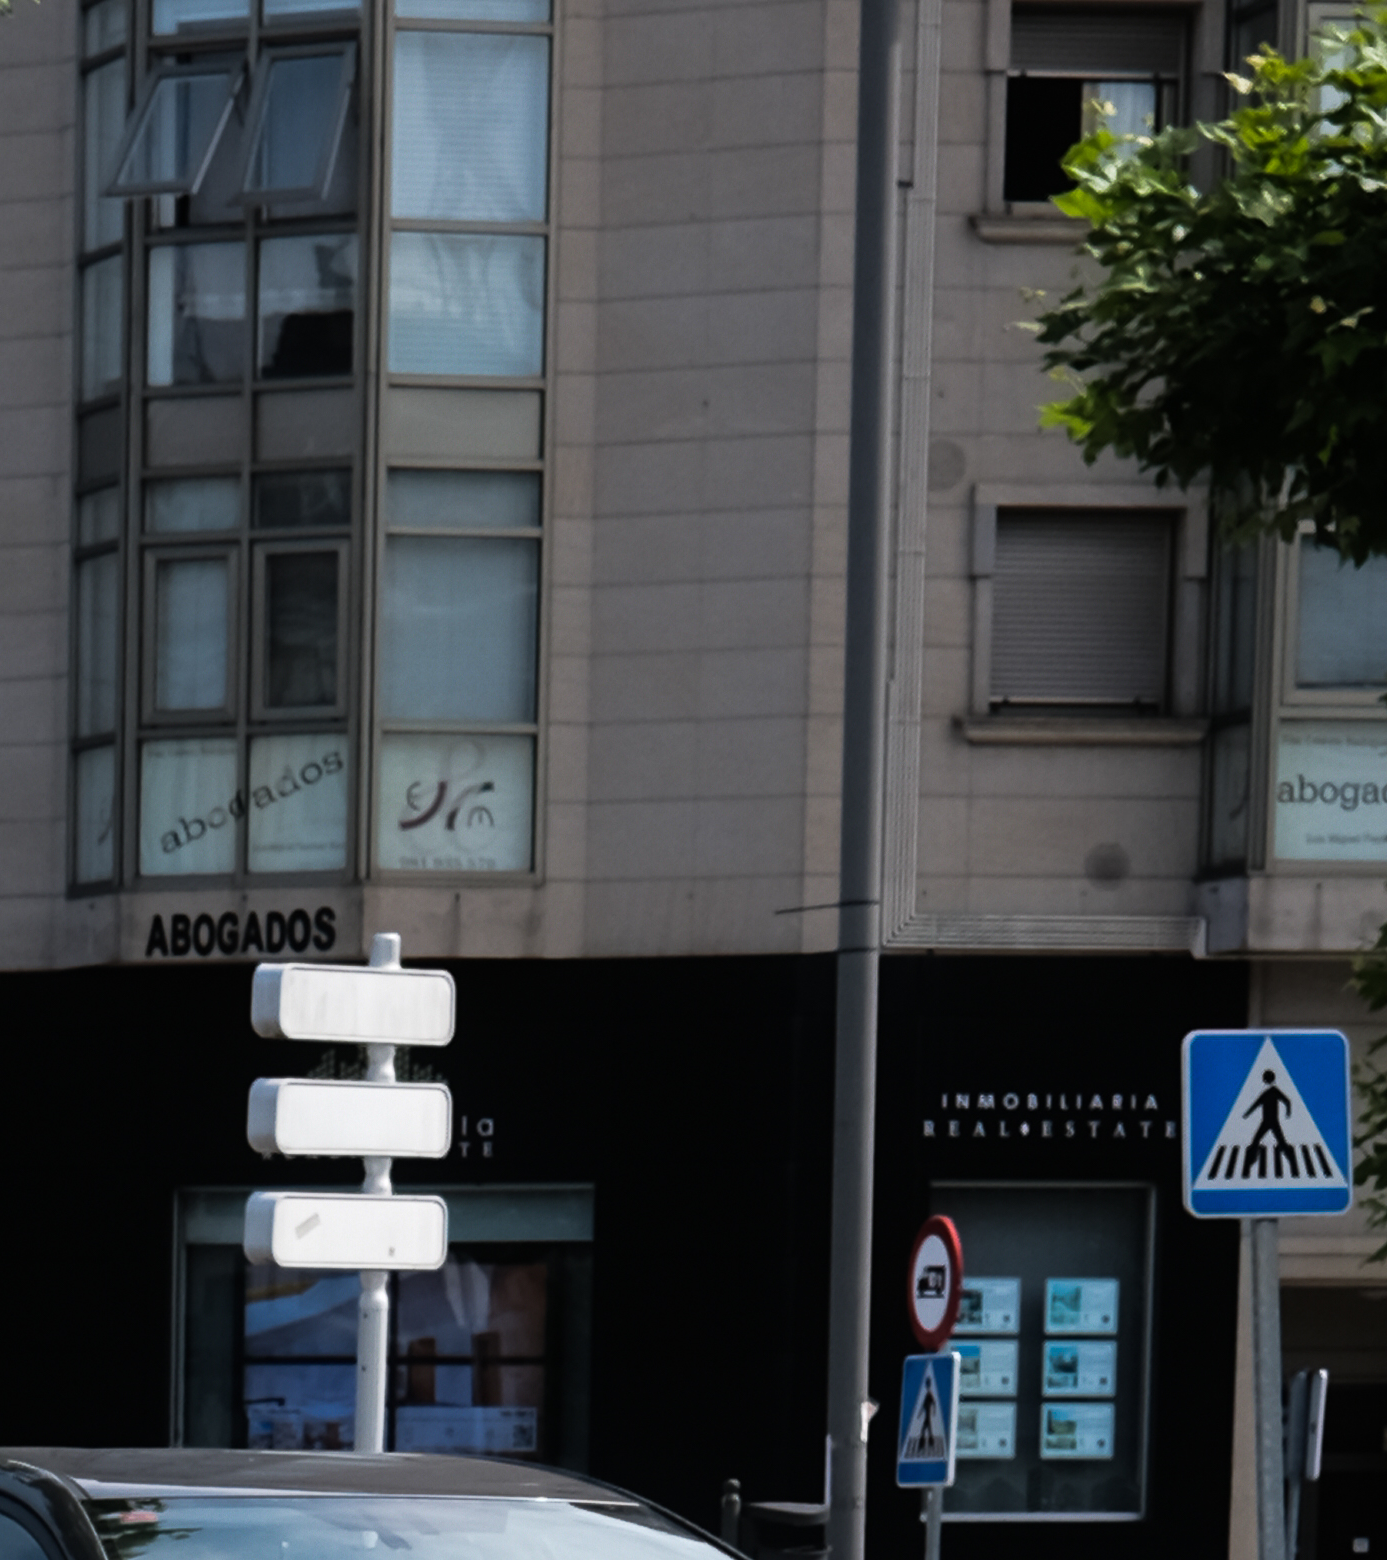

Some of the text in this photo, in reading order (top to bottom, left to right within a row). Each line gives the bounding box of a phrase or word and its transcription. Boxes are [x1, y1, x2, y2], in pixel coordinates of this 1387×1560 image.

[144, 906, 337, 957] ABOGADOS
[940, 1092, 1159, 1111] INMOBILIARIA
[922, 1119, 1177, 1138] REAL ESTATE
